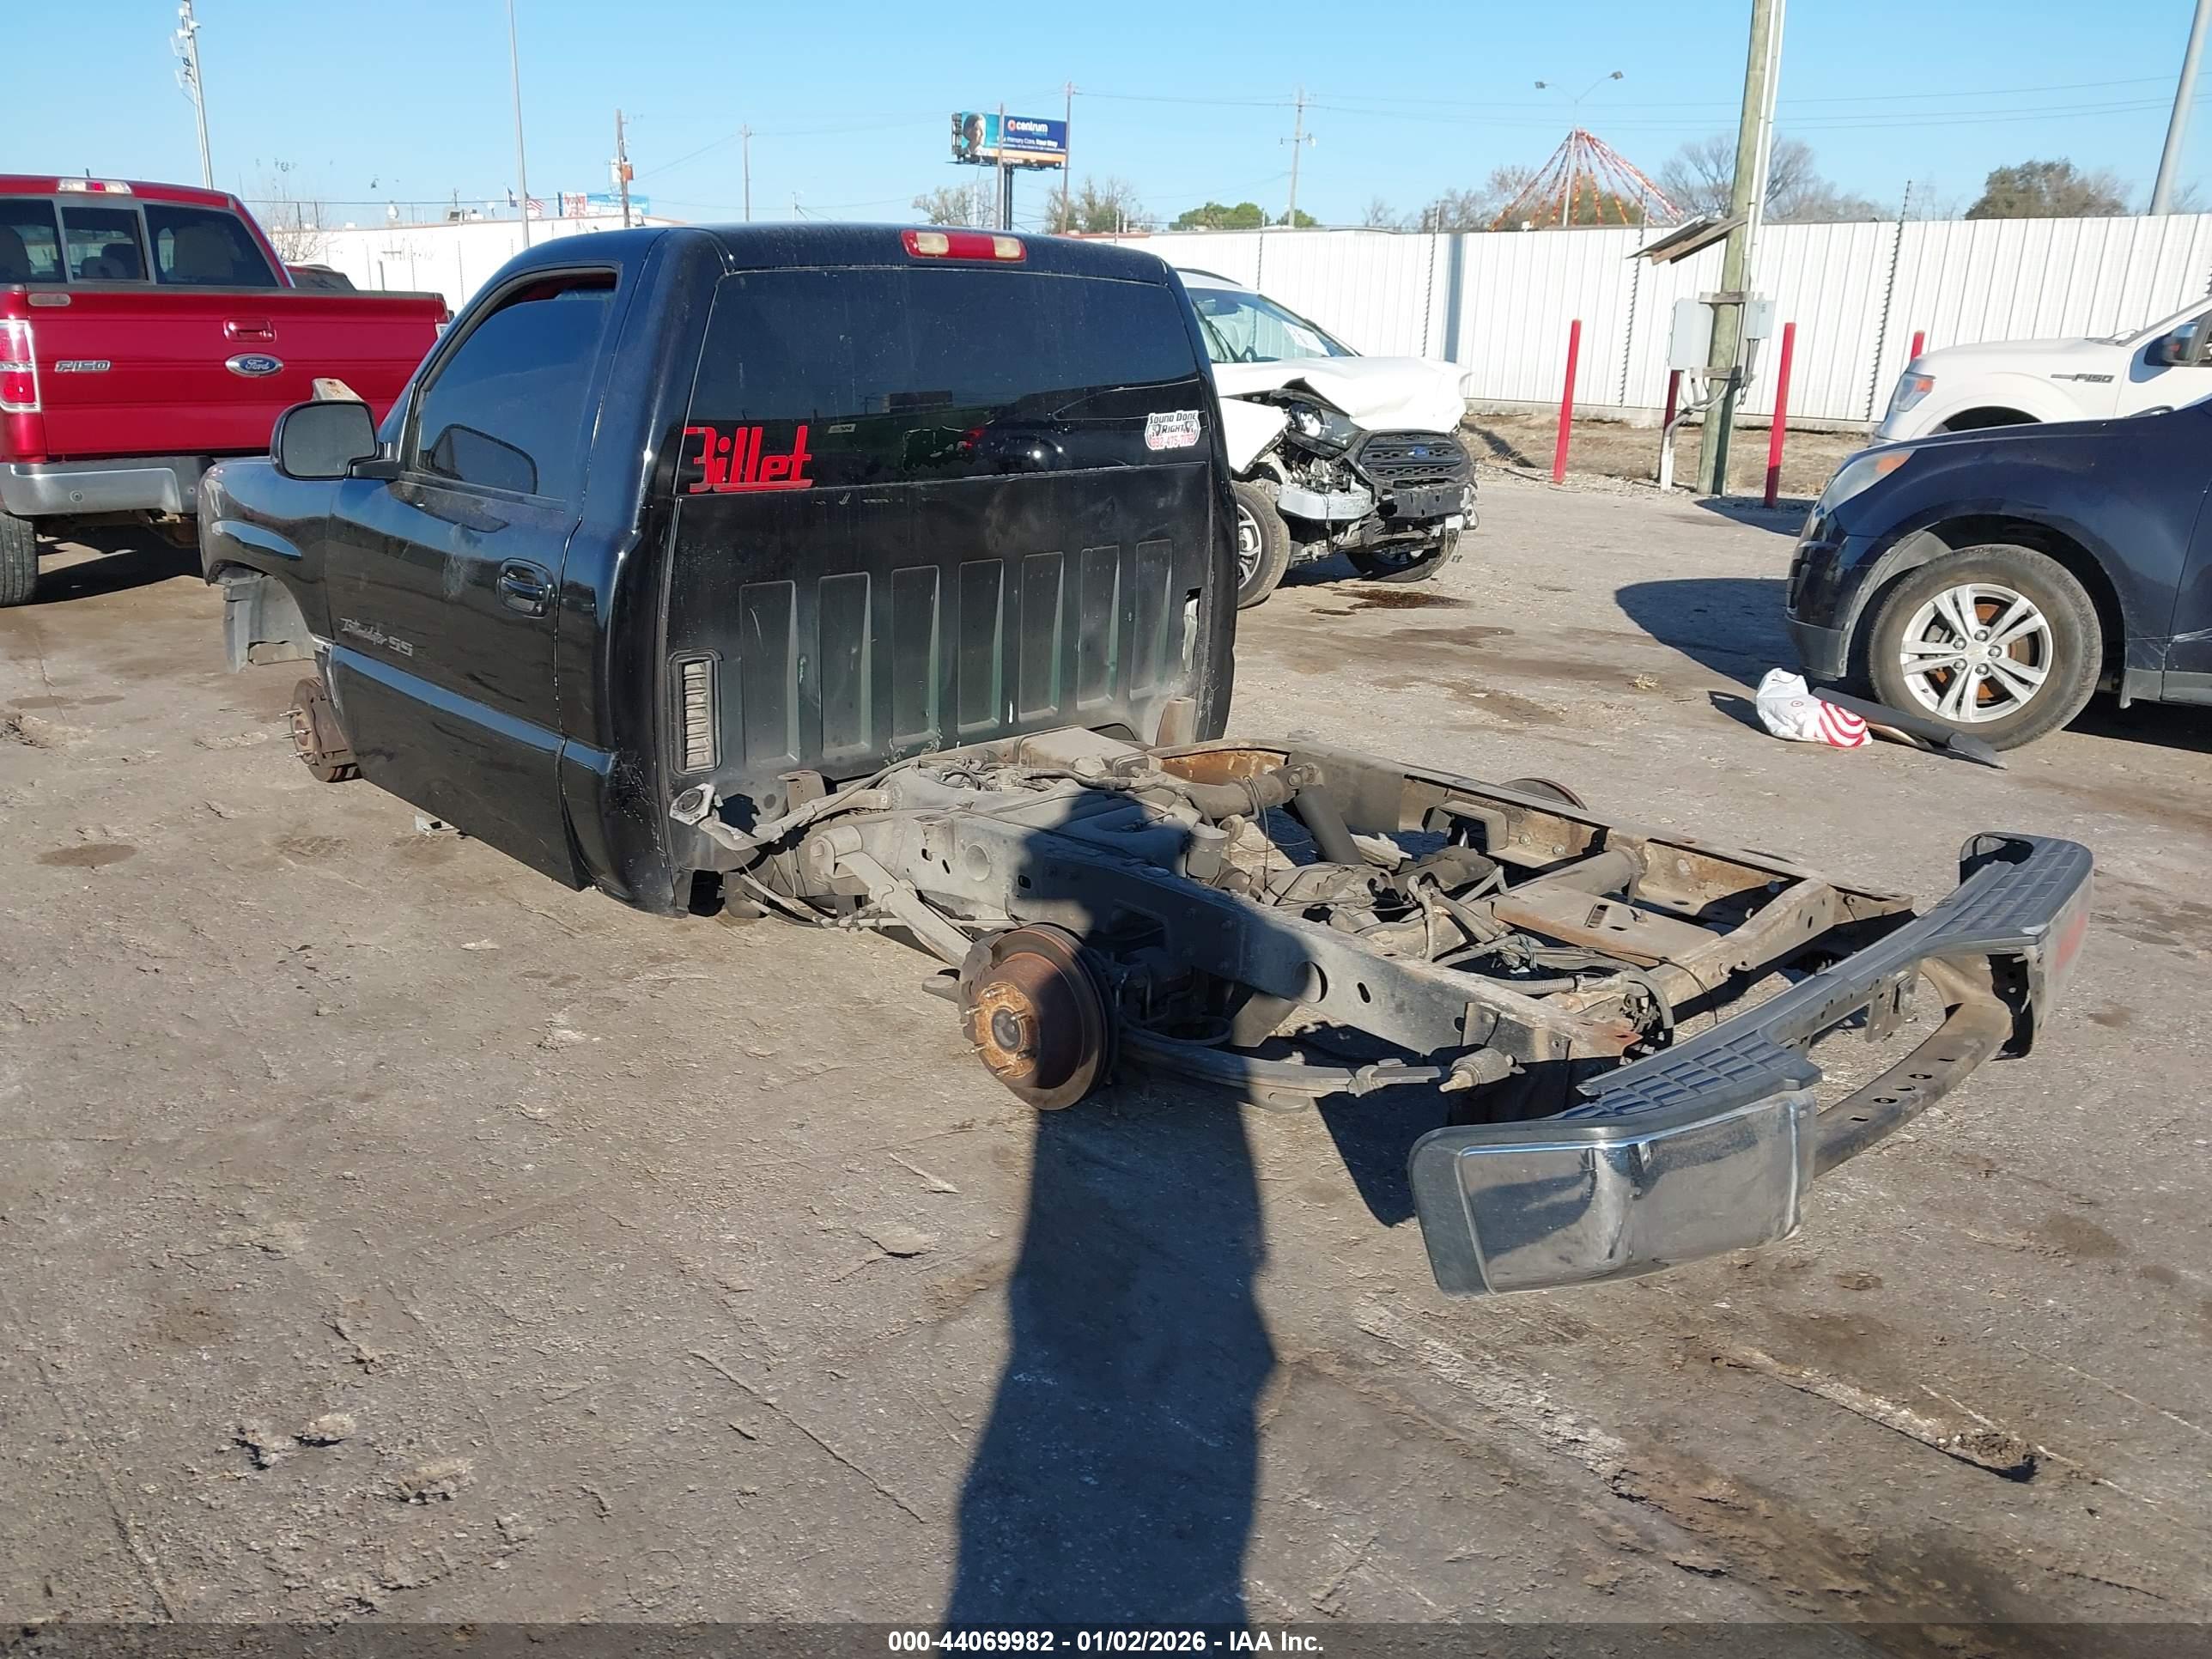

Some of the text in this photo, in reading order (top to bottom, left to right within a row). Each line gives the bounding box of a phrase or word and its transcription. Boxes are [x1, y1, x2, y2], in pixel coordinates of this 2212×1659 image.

[1016, 120, 1048, 132] centrum
[246, 359, 270, 370] Ford
[684, 426, 813, 493] Billet
[388, 635, 412, 656] SS
